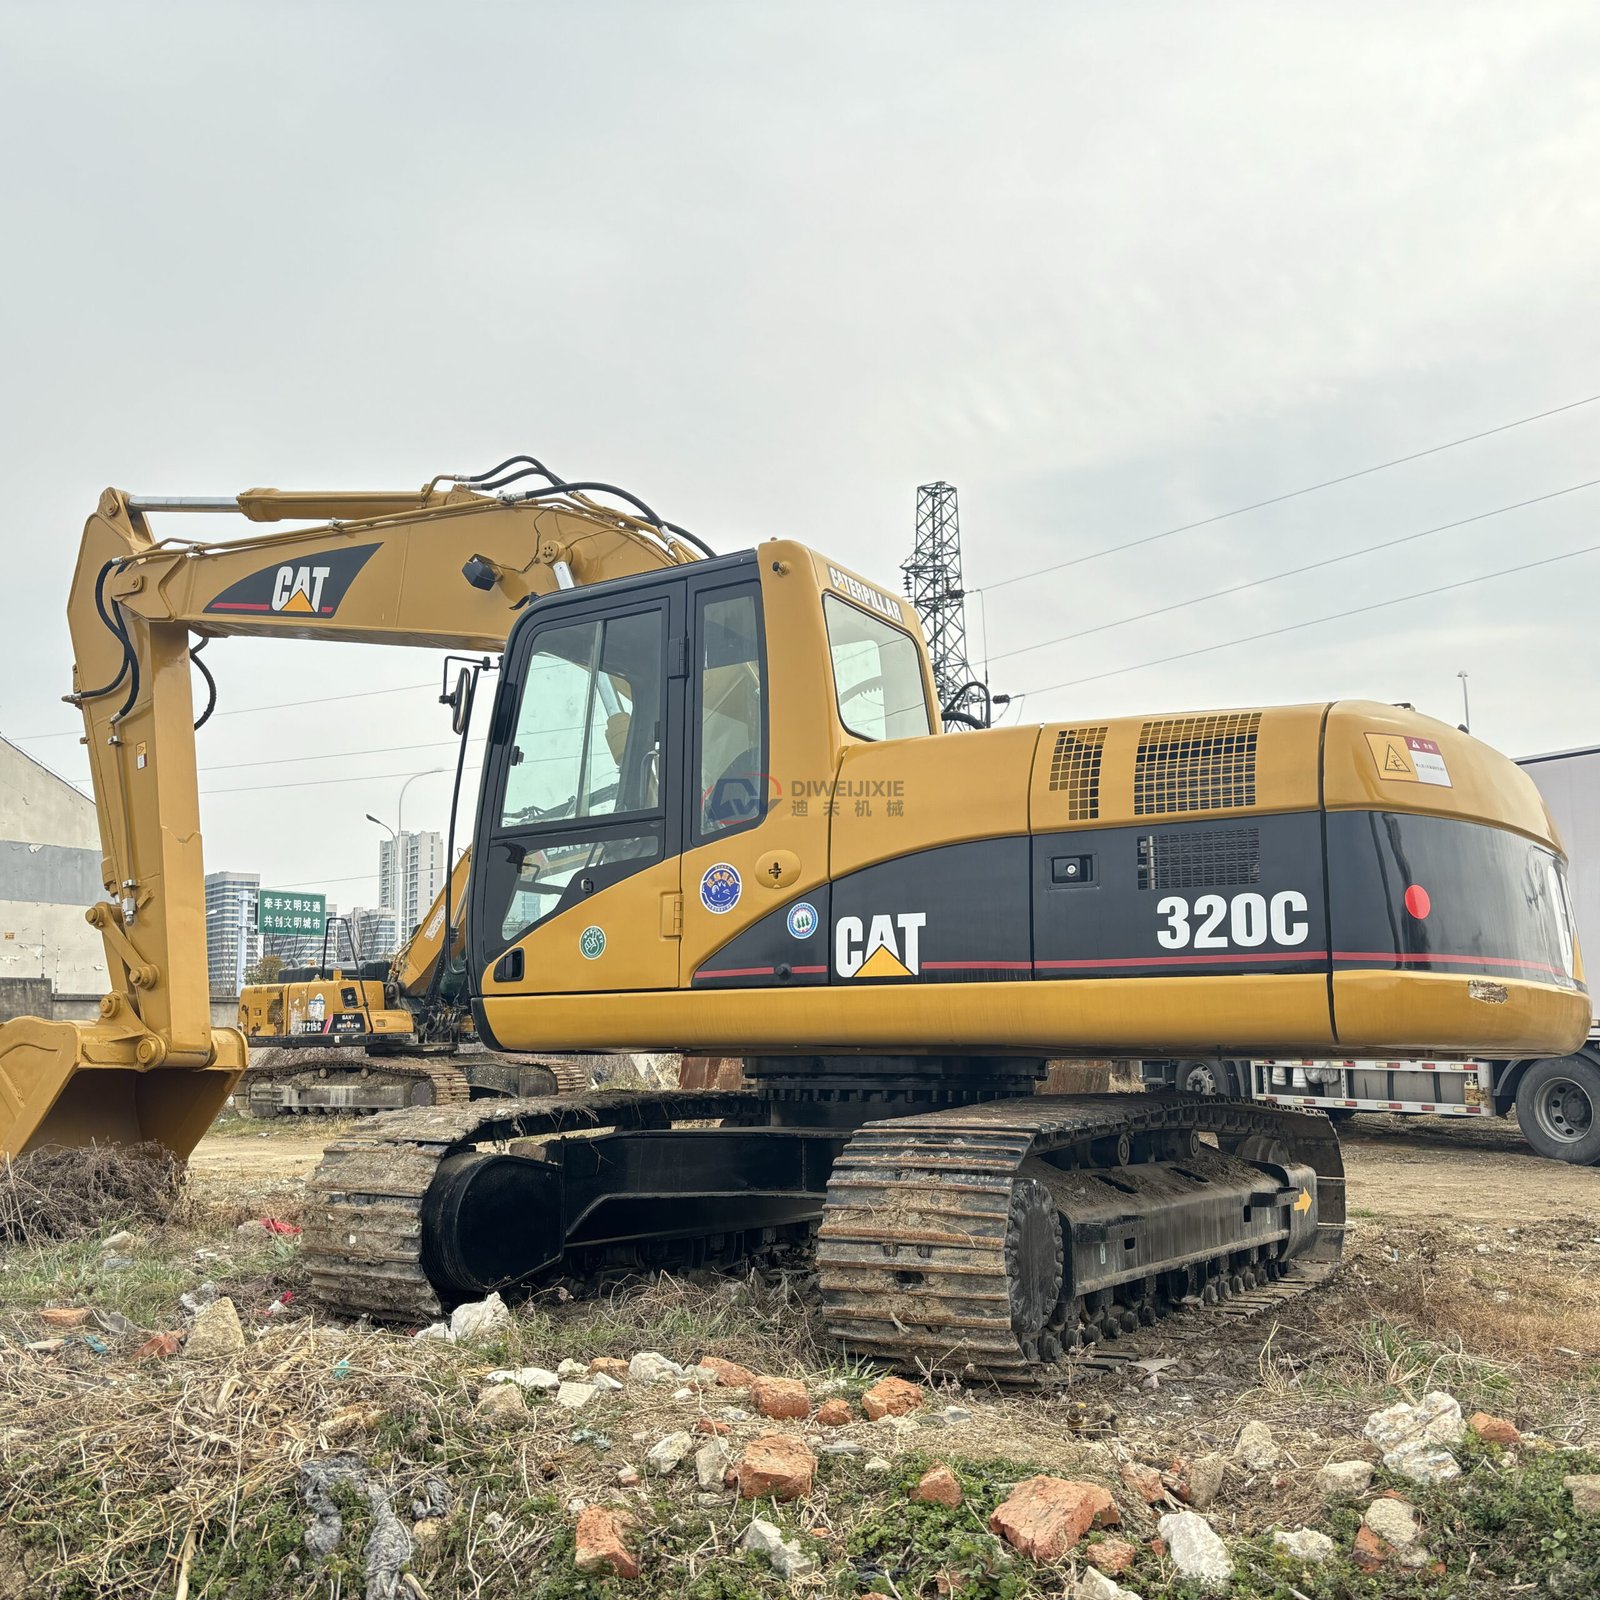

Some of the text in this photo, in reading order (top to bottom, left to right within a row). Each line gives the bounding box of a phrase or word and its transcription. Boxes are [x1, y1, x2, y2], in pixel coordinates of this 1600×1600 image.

[272, 566, 330, 612] CAT
[829, 566, 903, 623] CATERPILLAR
[264, 897, 321, 913] 牵手文明交通
[264, 915, 321, 930] 共创文明城市
[1157, 890, 1309, 949] 320C
[836, 912, 926, 978] CAT
